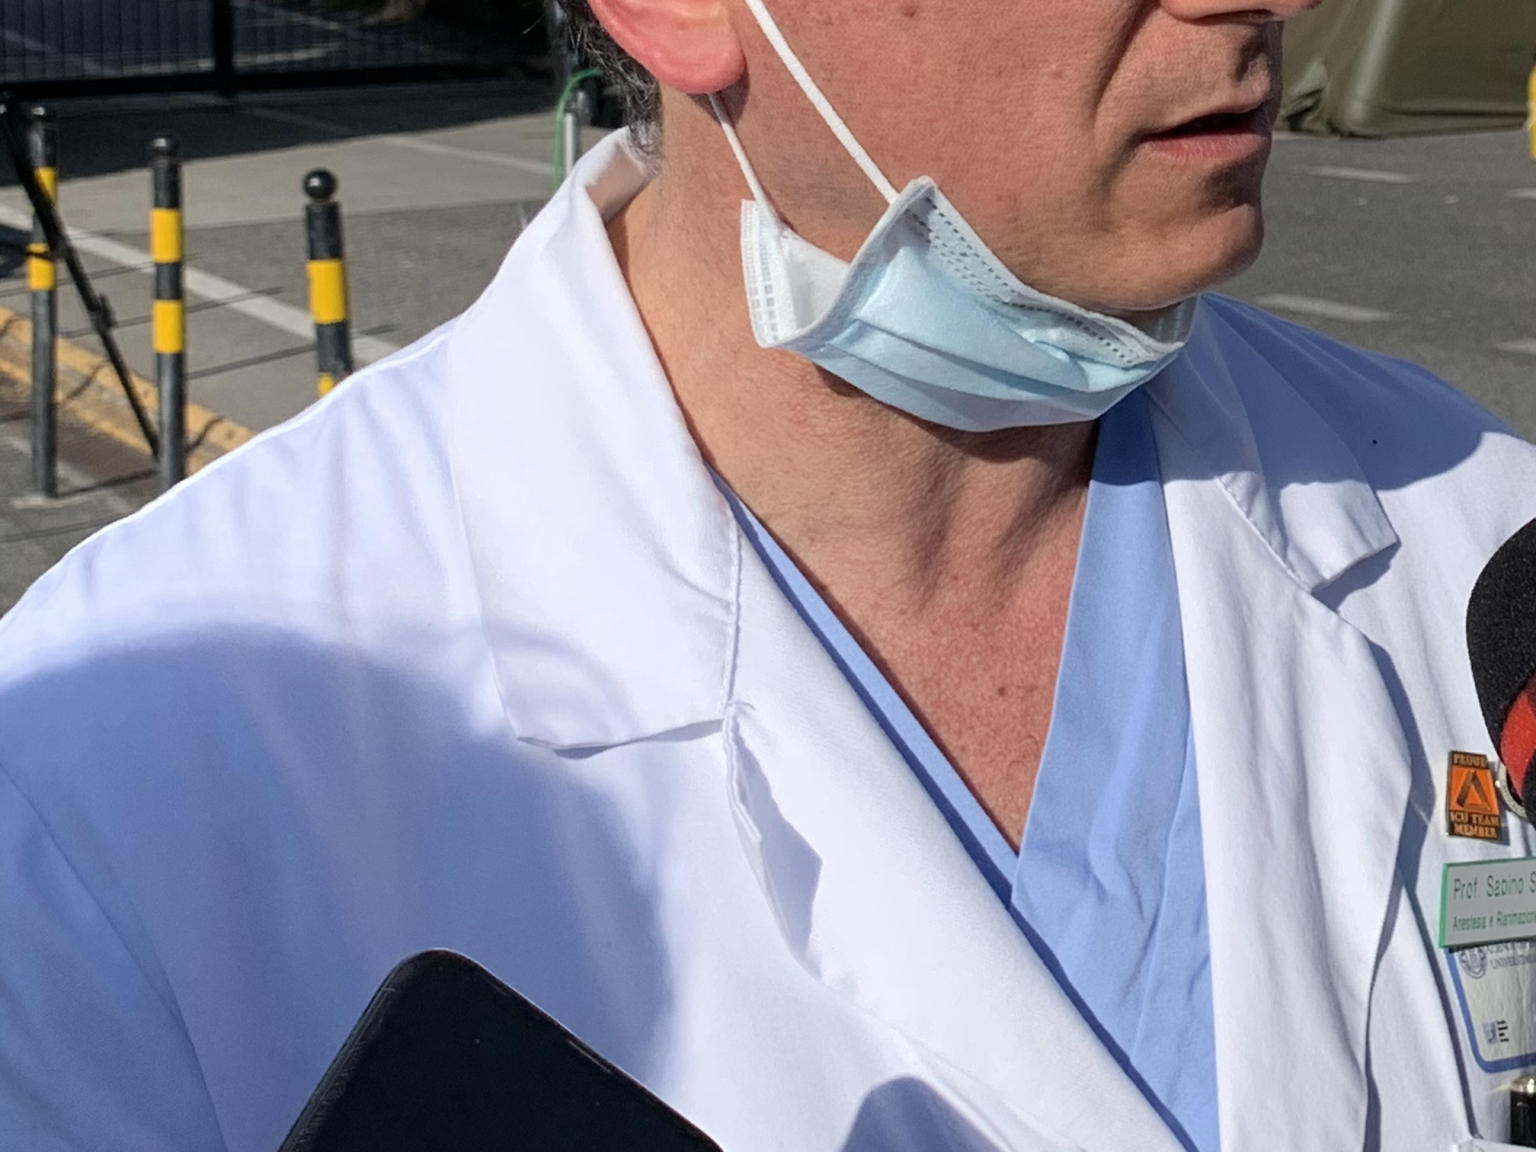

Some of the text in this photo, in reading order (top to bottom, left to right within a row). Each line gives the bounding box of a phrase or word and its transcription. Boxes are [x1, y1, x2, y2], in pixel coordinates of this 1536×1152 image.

[1449, 811, 1500, 827] ICU TEAM
[1453, 824, 1498, 839] MEMBER
[1486, 874, 1525, 898] Sabino
